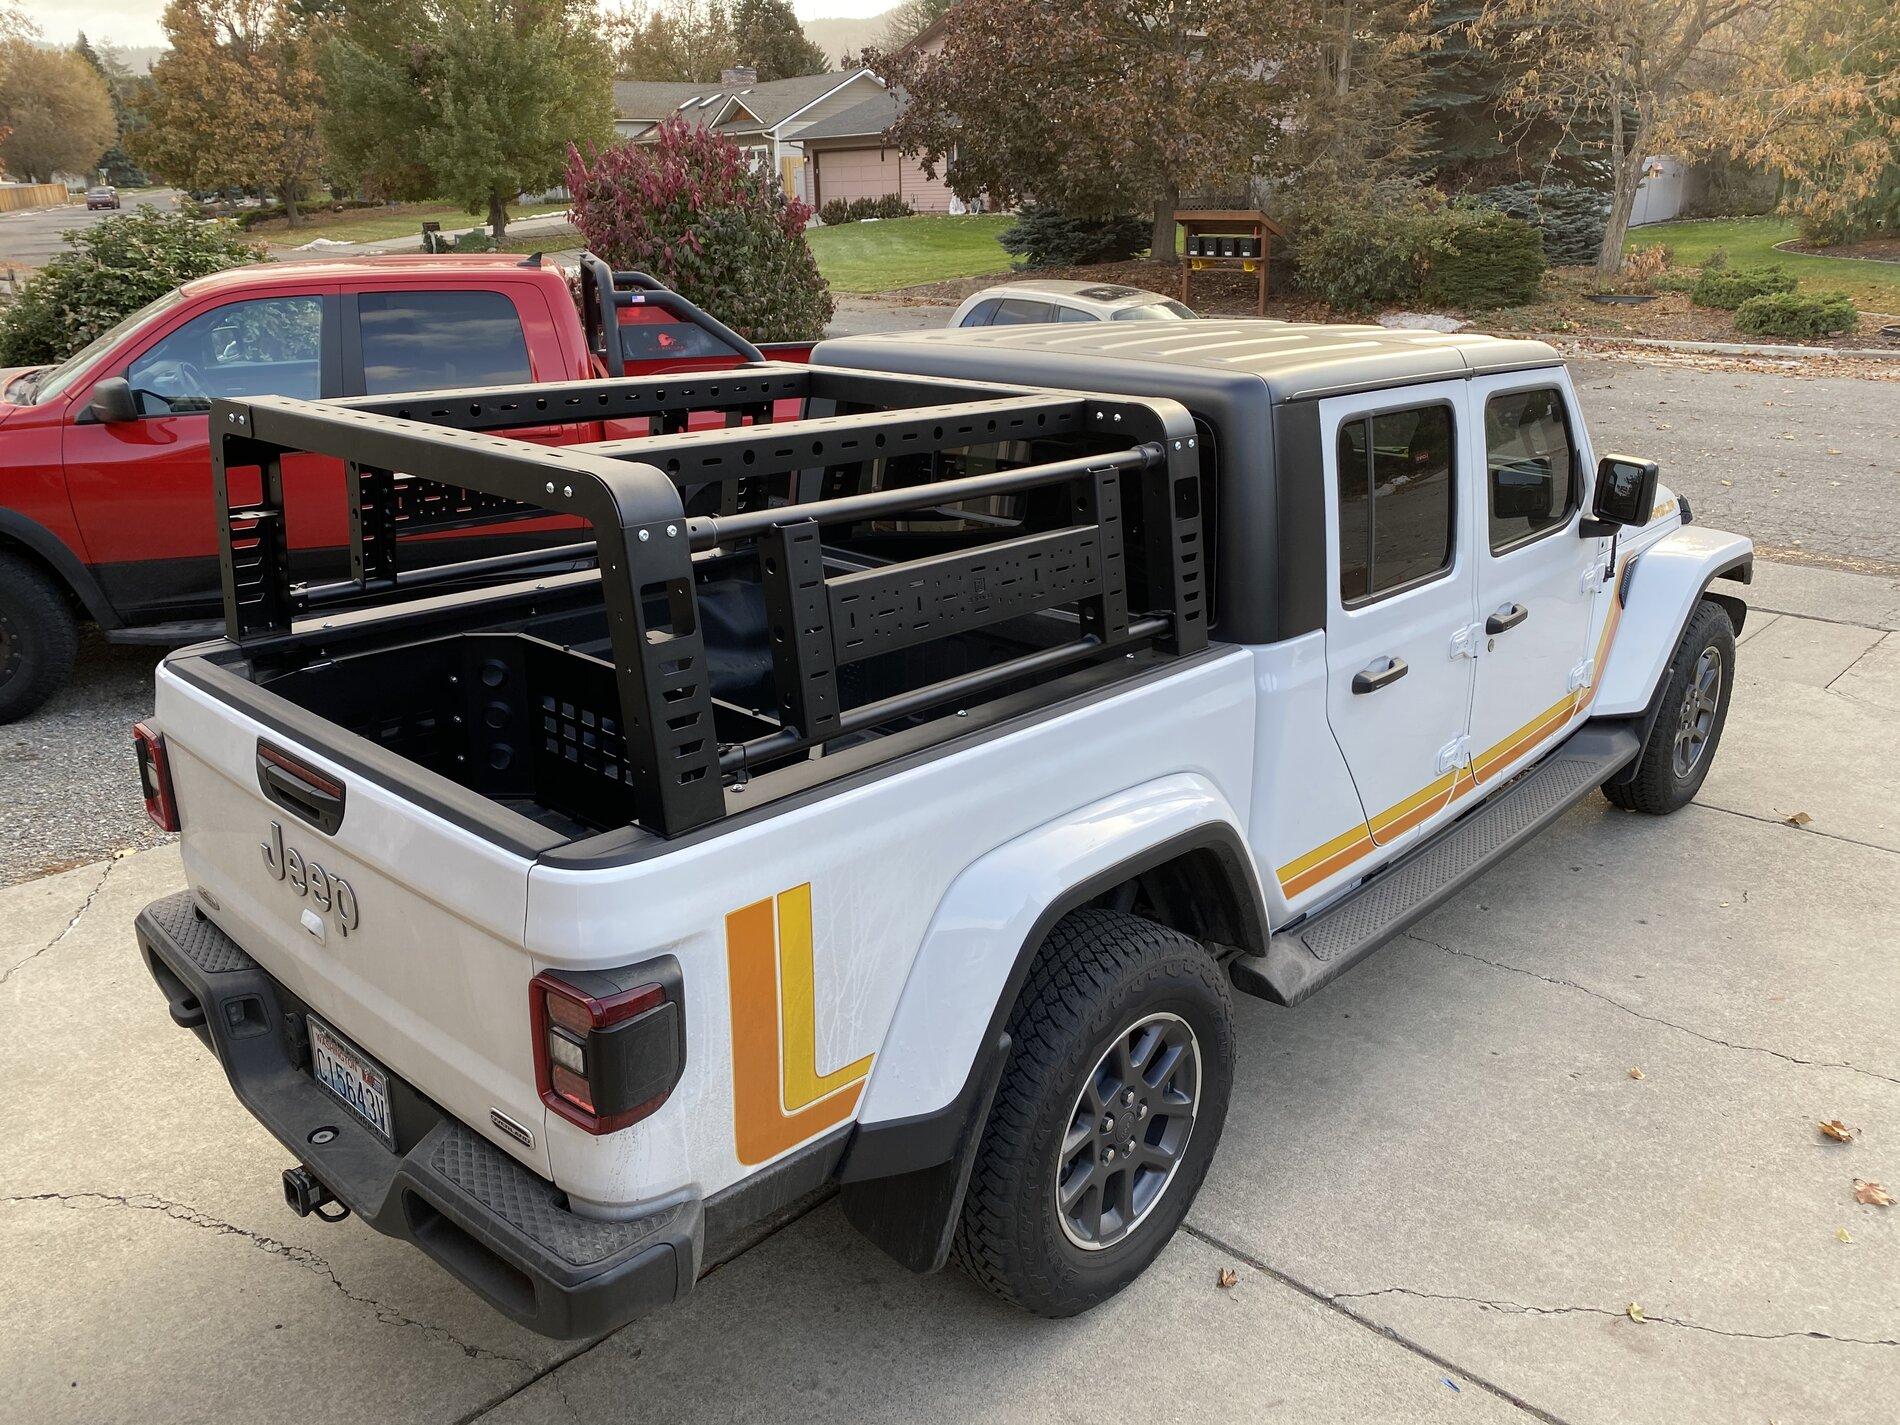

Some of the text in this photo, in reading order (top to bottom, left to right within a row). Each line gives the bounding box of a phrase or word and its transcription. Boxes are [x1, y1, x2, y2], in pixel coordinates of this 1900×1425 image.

[260, 820, 359, 938] Jeep
[315, 1031, 358, 1073] WASHINGTON
[316, 1048, 385, 1132] C15643V
[490, 1113, 531, 1144] OVERLAND
